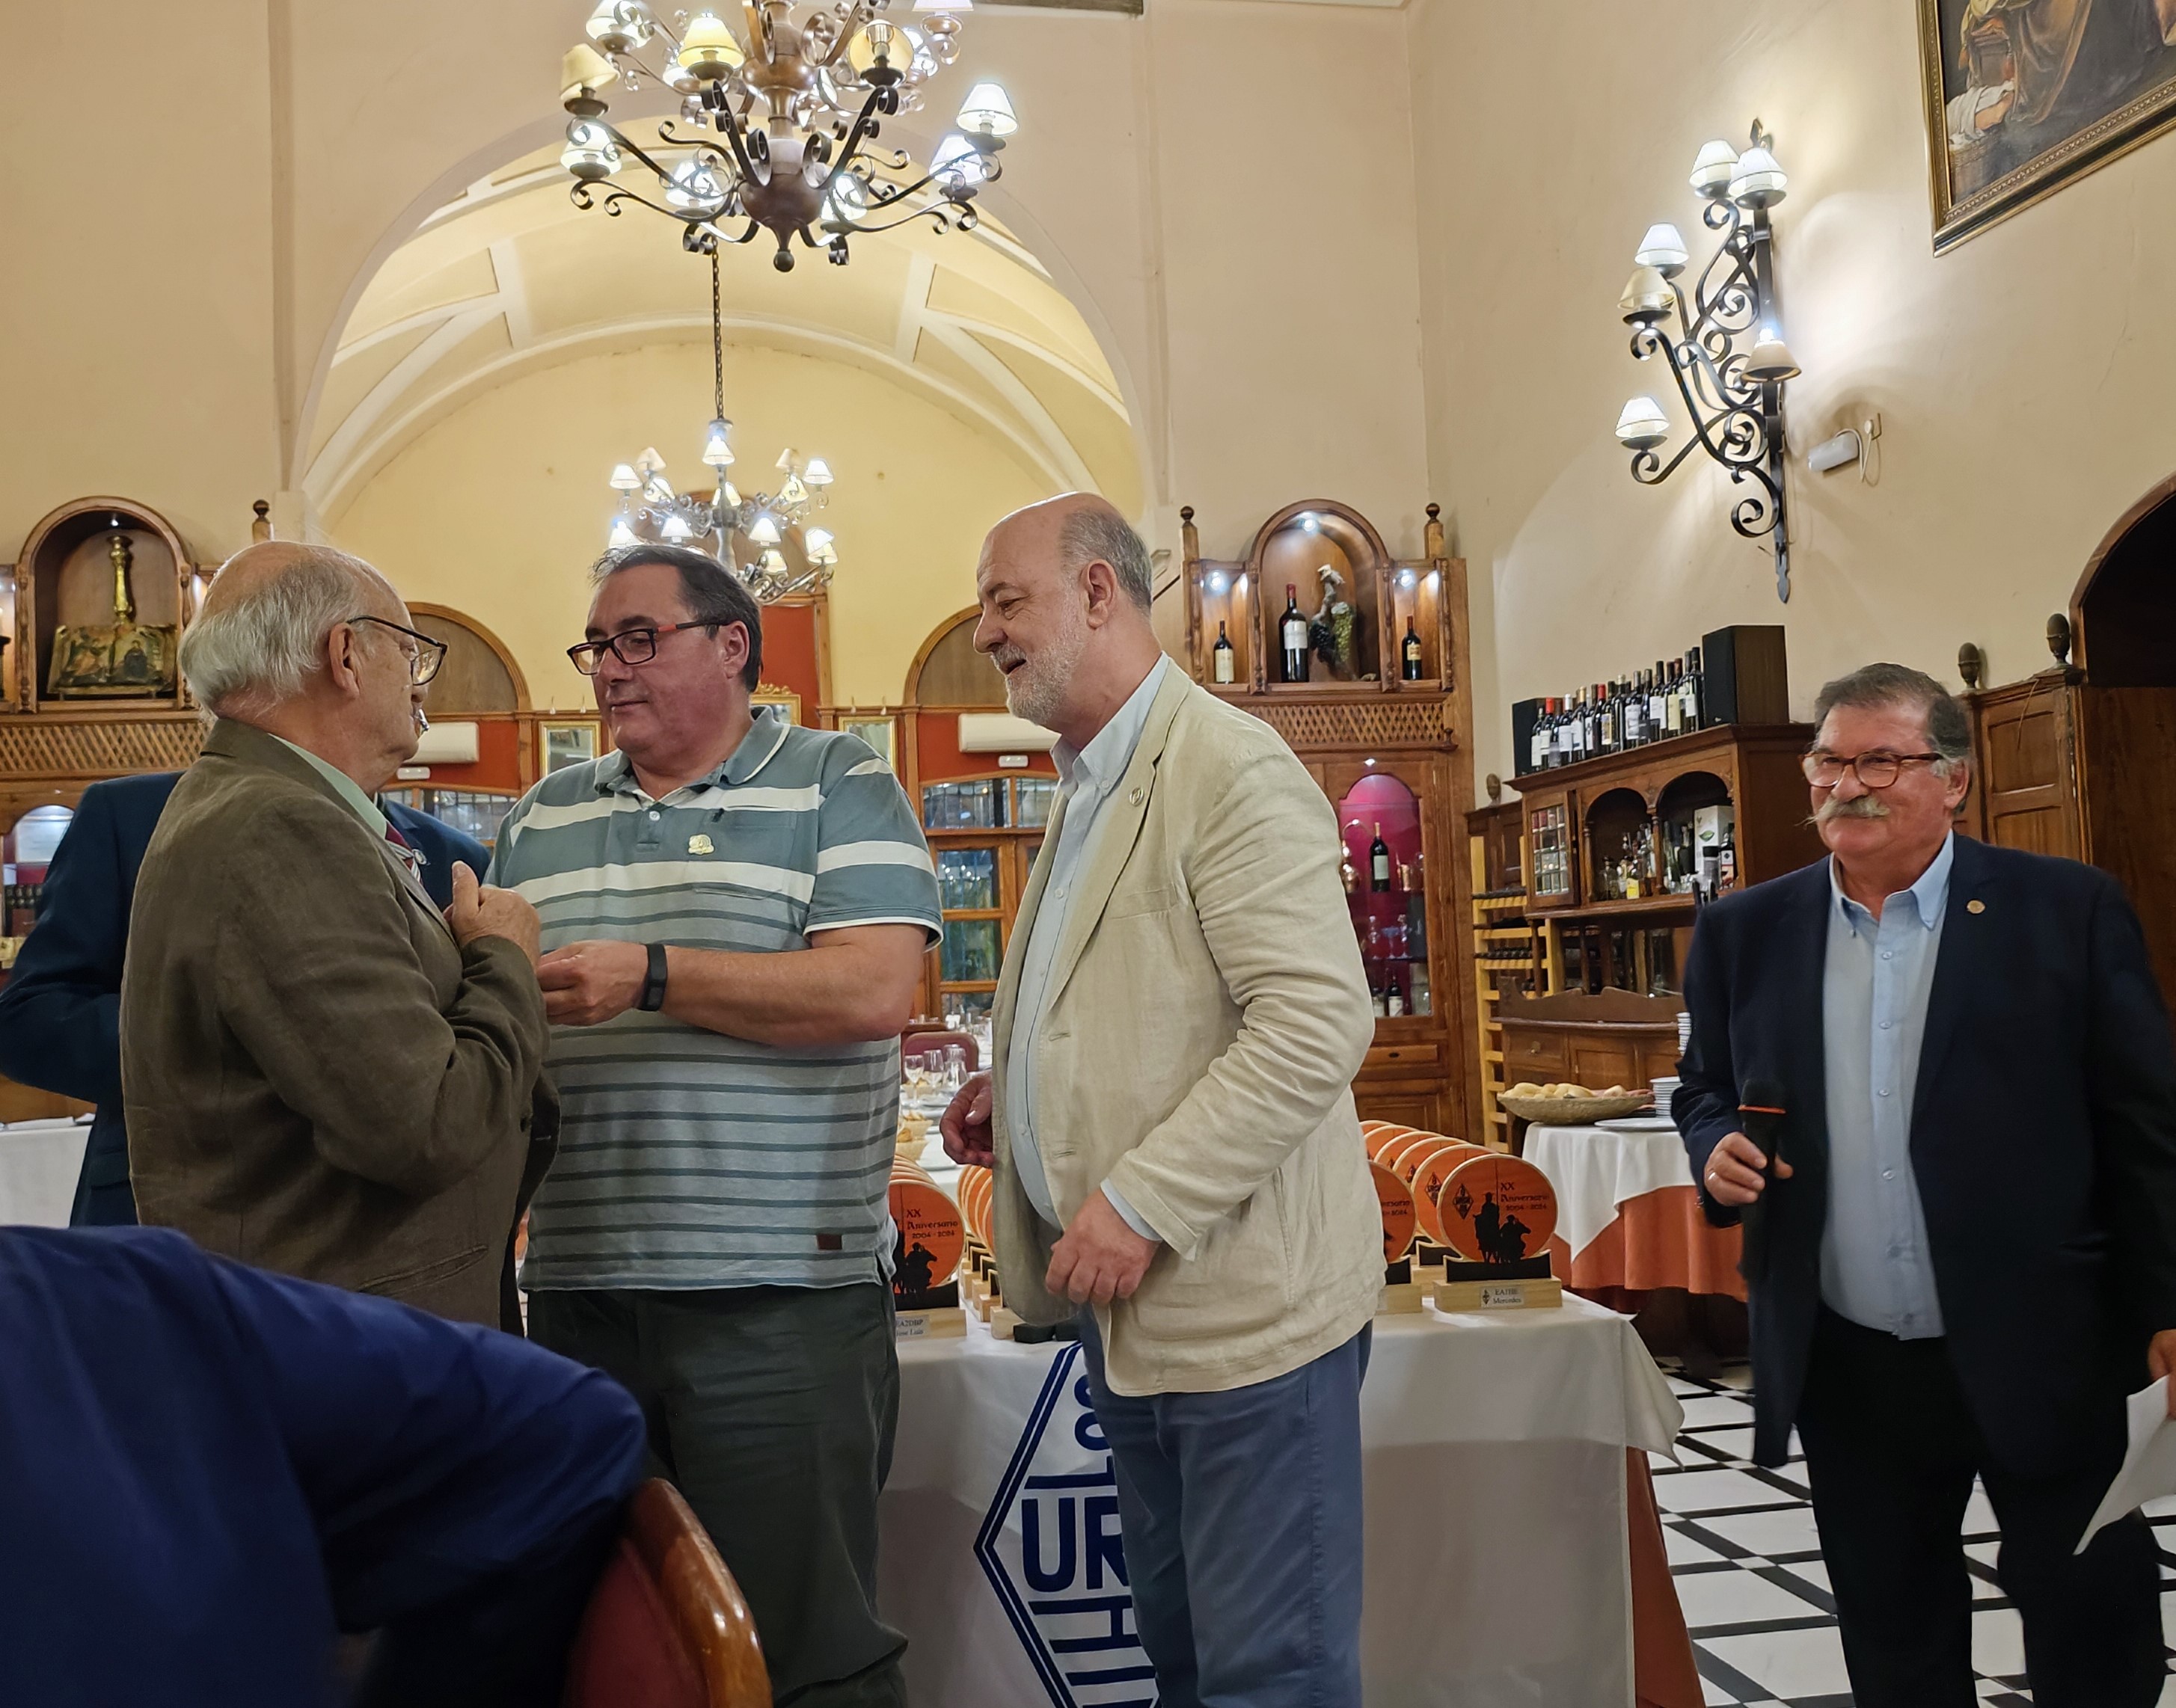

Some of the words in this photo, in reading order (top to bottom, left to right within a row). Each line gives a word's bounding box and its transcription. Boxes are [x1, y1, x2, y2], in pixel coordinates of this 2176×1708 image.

[1501, 1182, 1514, 1191] XX
[907, 1208, 921, 1218] XX
[907, 1221, 958, 1230] Aniversario
